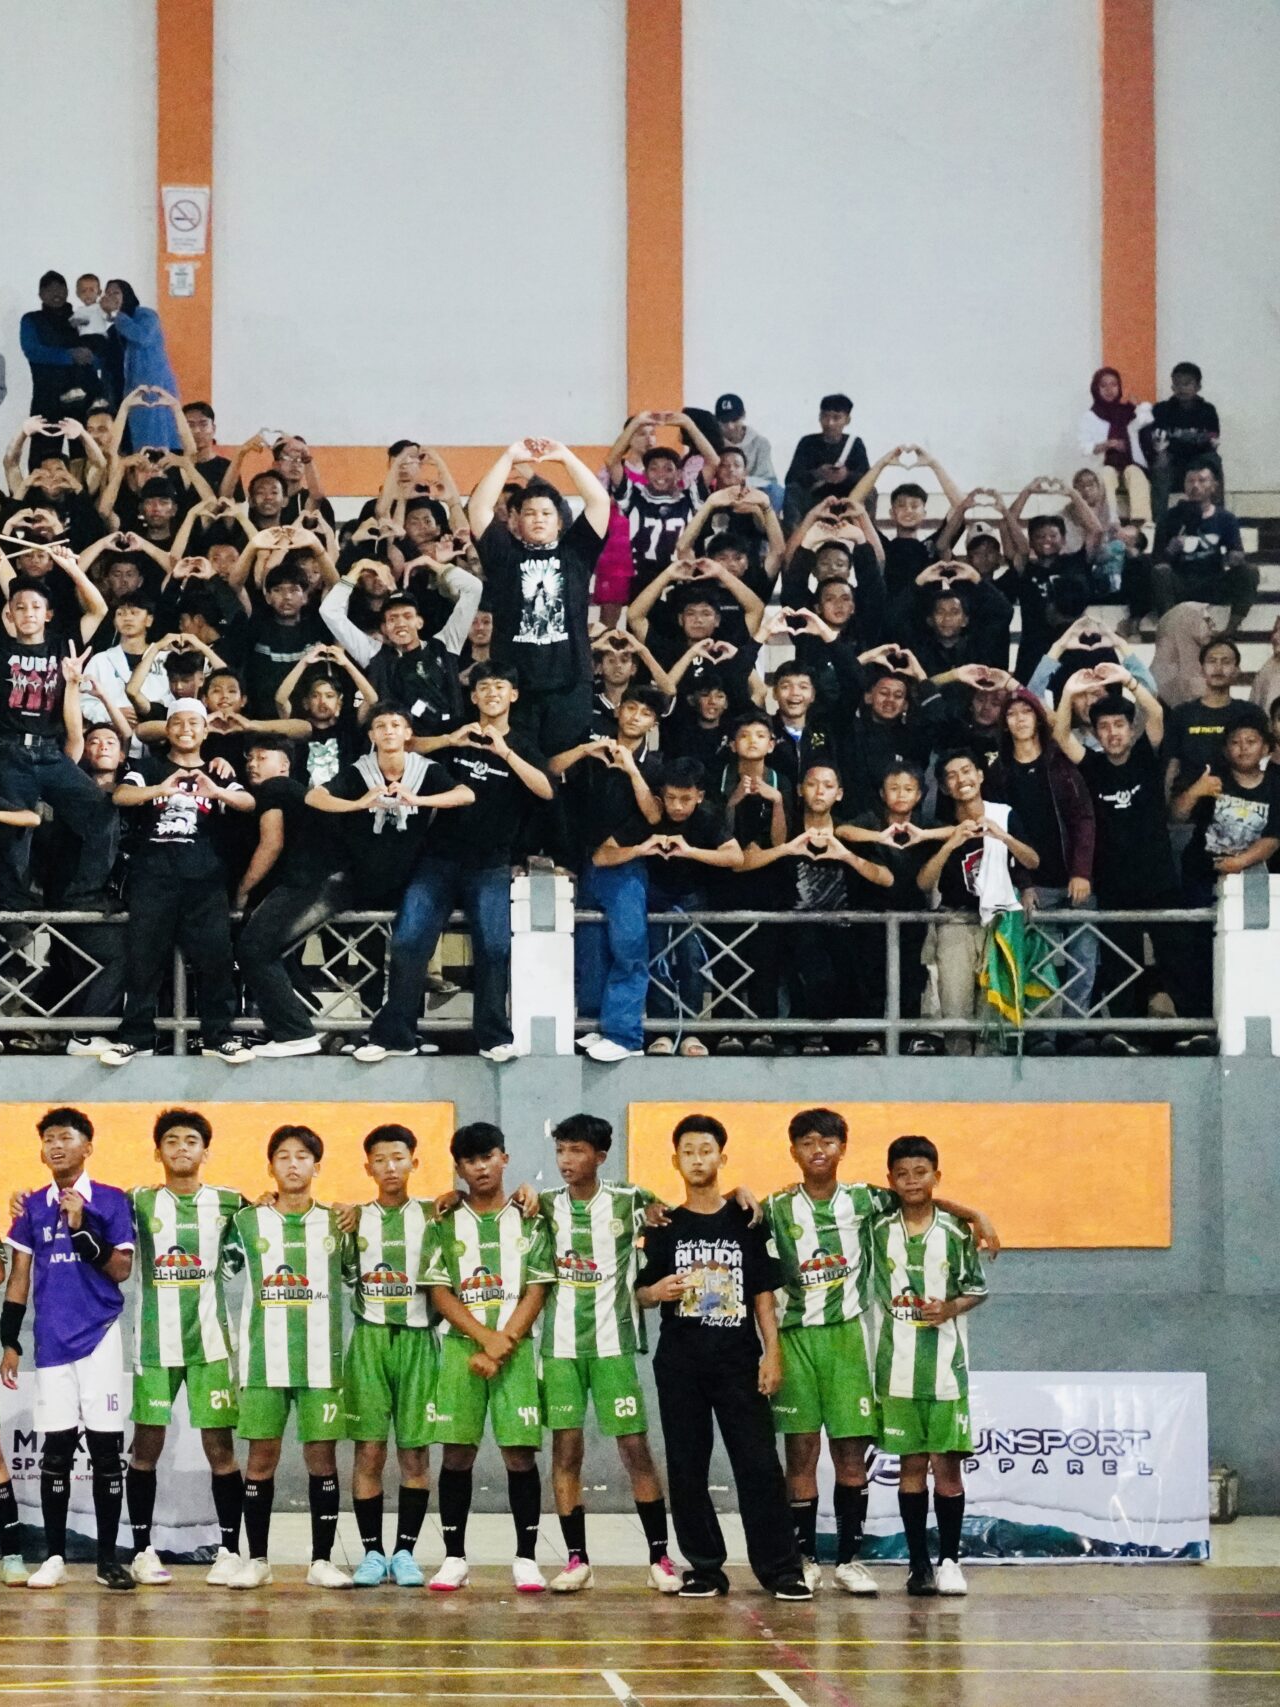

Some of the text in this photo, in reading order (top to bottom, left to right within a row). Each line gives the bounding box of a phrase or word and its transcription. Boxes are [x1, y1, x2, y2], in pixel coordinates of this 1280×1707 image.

[675, 1249, 743, 1267] ALHUDA
[106, 1392, 119, 1412] 16
[210, 1389, 232, 1410] 24
[614, 1396, 637, 1418] 29
[859, 1397, 870, 1417] 9
[517, 1405, 539, 1426] 44
[964, 1458, 1154, 1476] PPAREL
